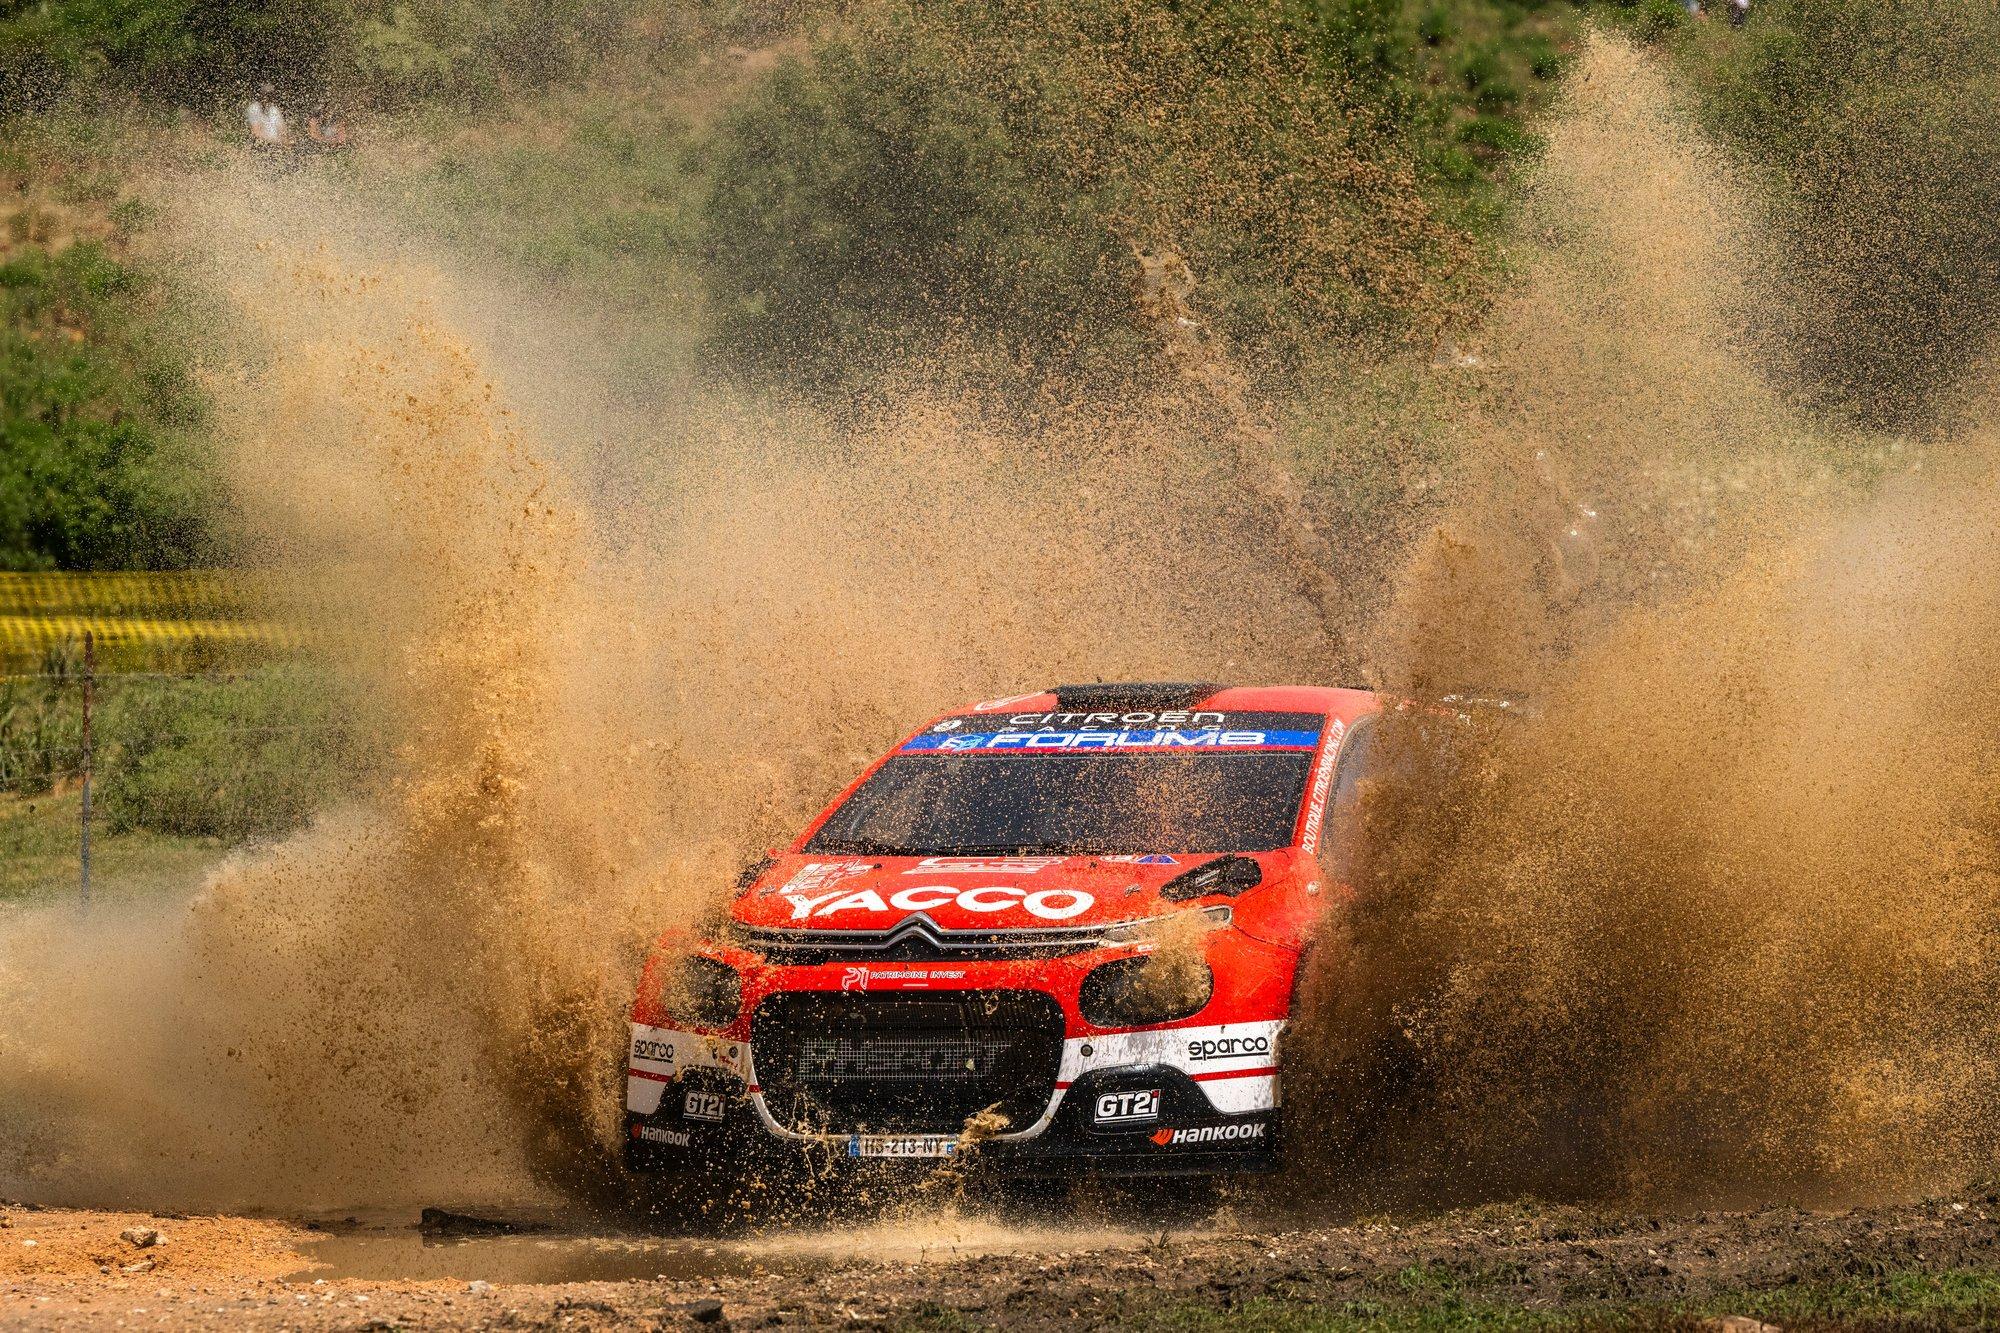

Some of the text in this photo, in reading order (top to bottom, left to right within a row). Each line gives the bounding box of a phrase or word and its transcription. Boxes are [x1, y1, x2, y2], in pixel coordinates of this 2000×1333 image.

[1010, 711, 1225, 724] CITROËN
[987, 732, 1266, 747] FORUM8
[785, 886, 1094, 919] YACCO
[870, 971, 928, 980] PATRIMOINE
[930, 971, 965, 980] INVEST
[634, 1039, 675, 1060] sparco
[1188, 1037, 1268, 1060] sparco
[684, 1092, 726, 1117] GT2i
[1098, 1090, 1158, 1117] GT2i
